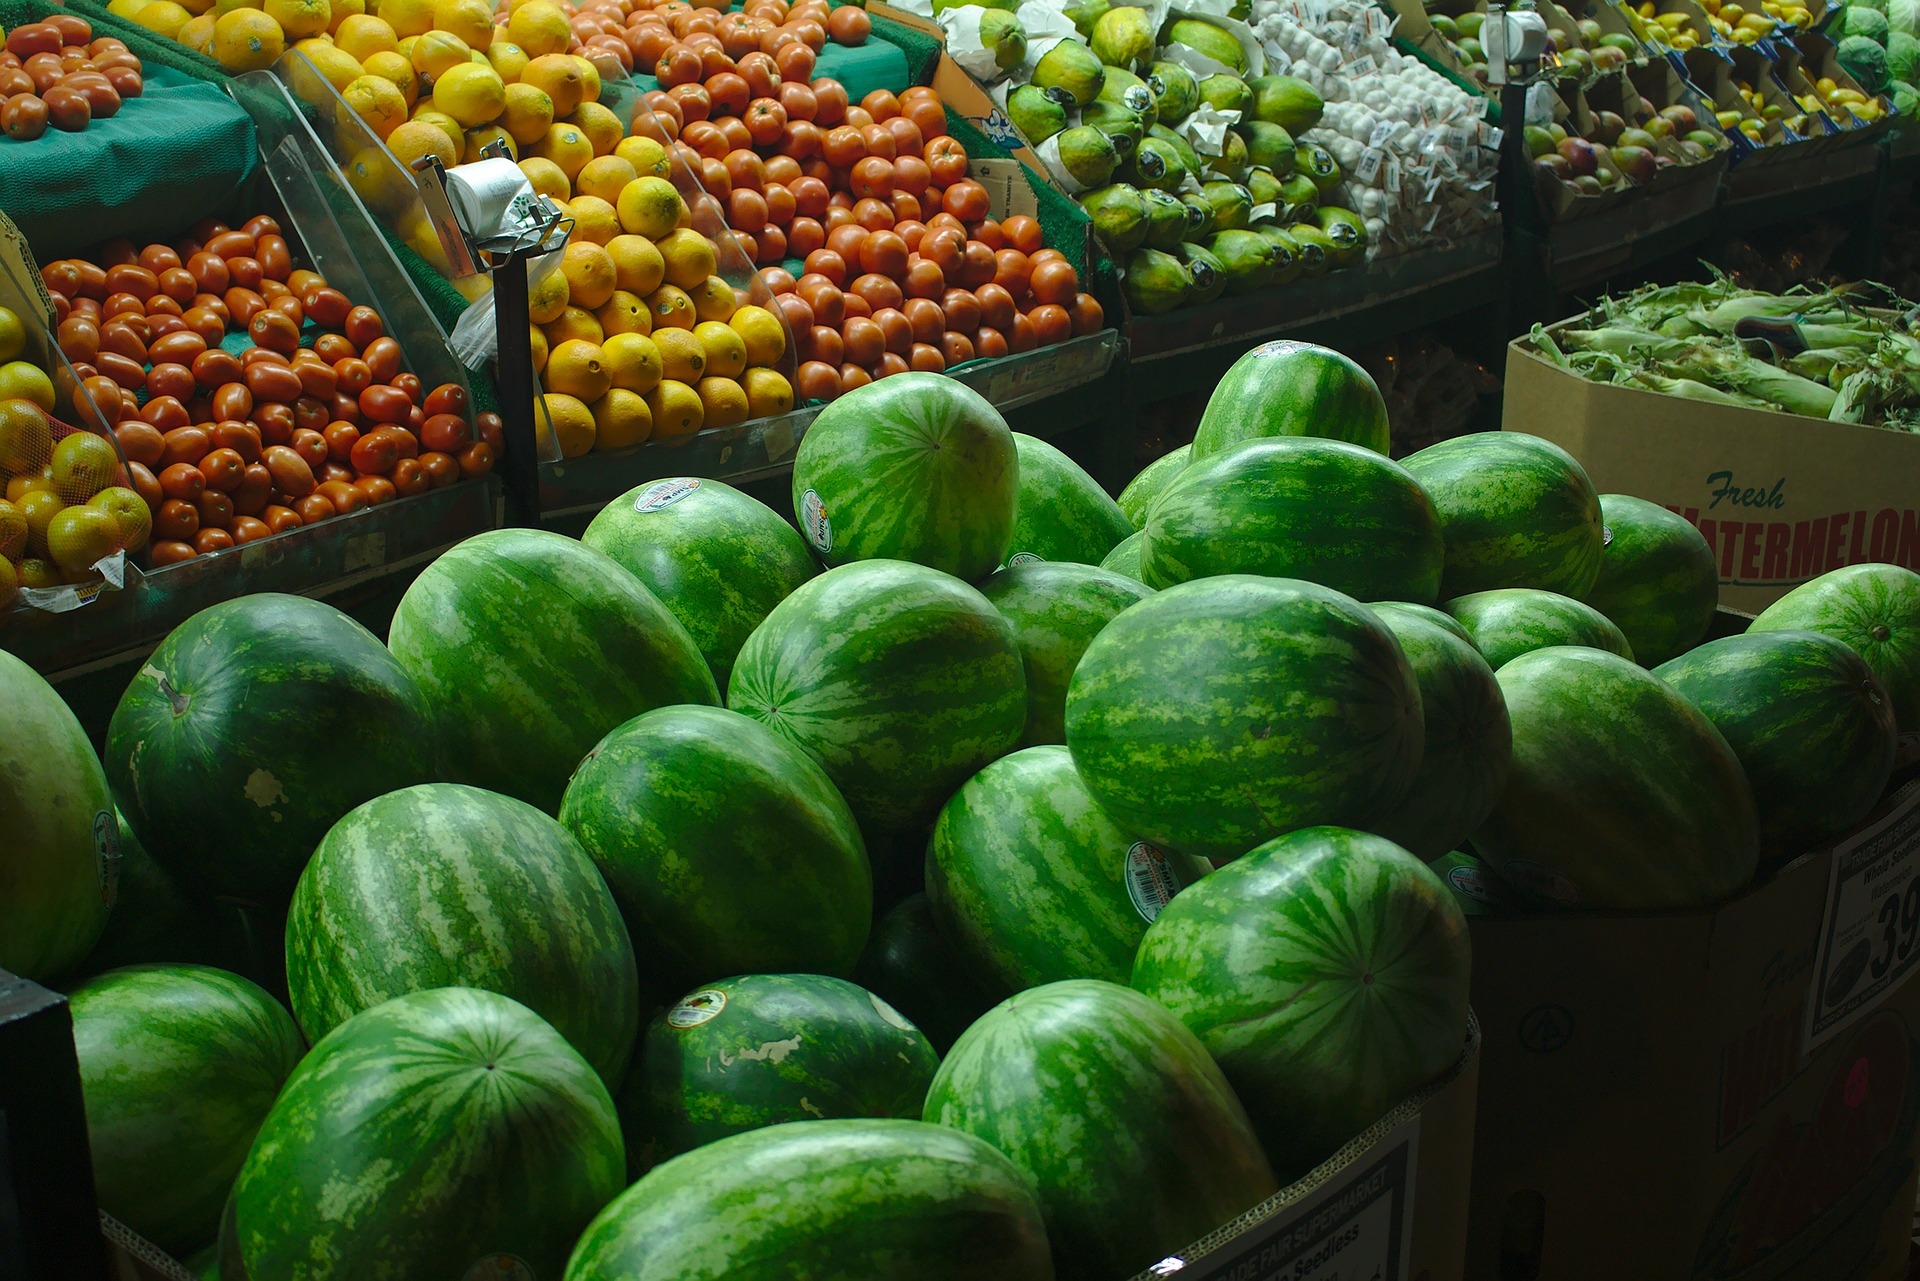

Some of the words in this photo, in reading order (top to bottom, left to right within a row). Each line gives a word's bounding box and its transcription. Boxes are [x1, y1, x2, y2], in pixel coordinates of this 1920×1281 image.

[1706, 470, 1786, 510] Fresh
[1851, 842, 1877, 870] TRADE
[1877, 830, 1894, 855] FAIR
[1863, 858, 1889, 885] Whole
[1871, 865, 1912, 902] Watermelon
[1869, 874, 1920, 978] 39
[1260, 1234, 1292, 1271] FAIR
[1294, 1165, 1388, 1245] SUPERMARKET
[1294, 1223, 1359, 1278] Seedless
